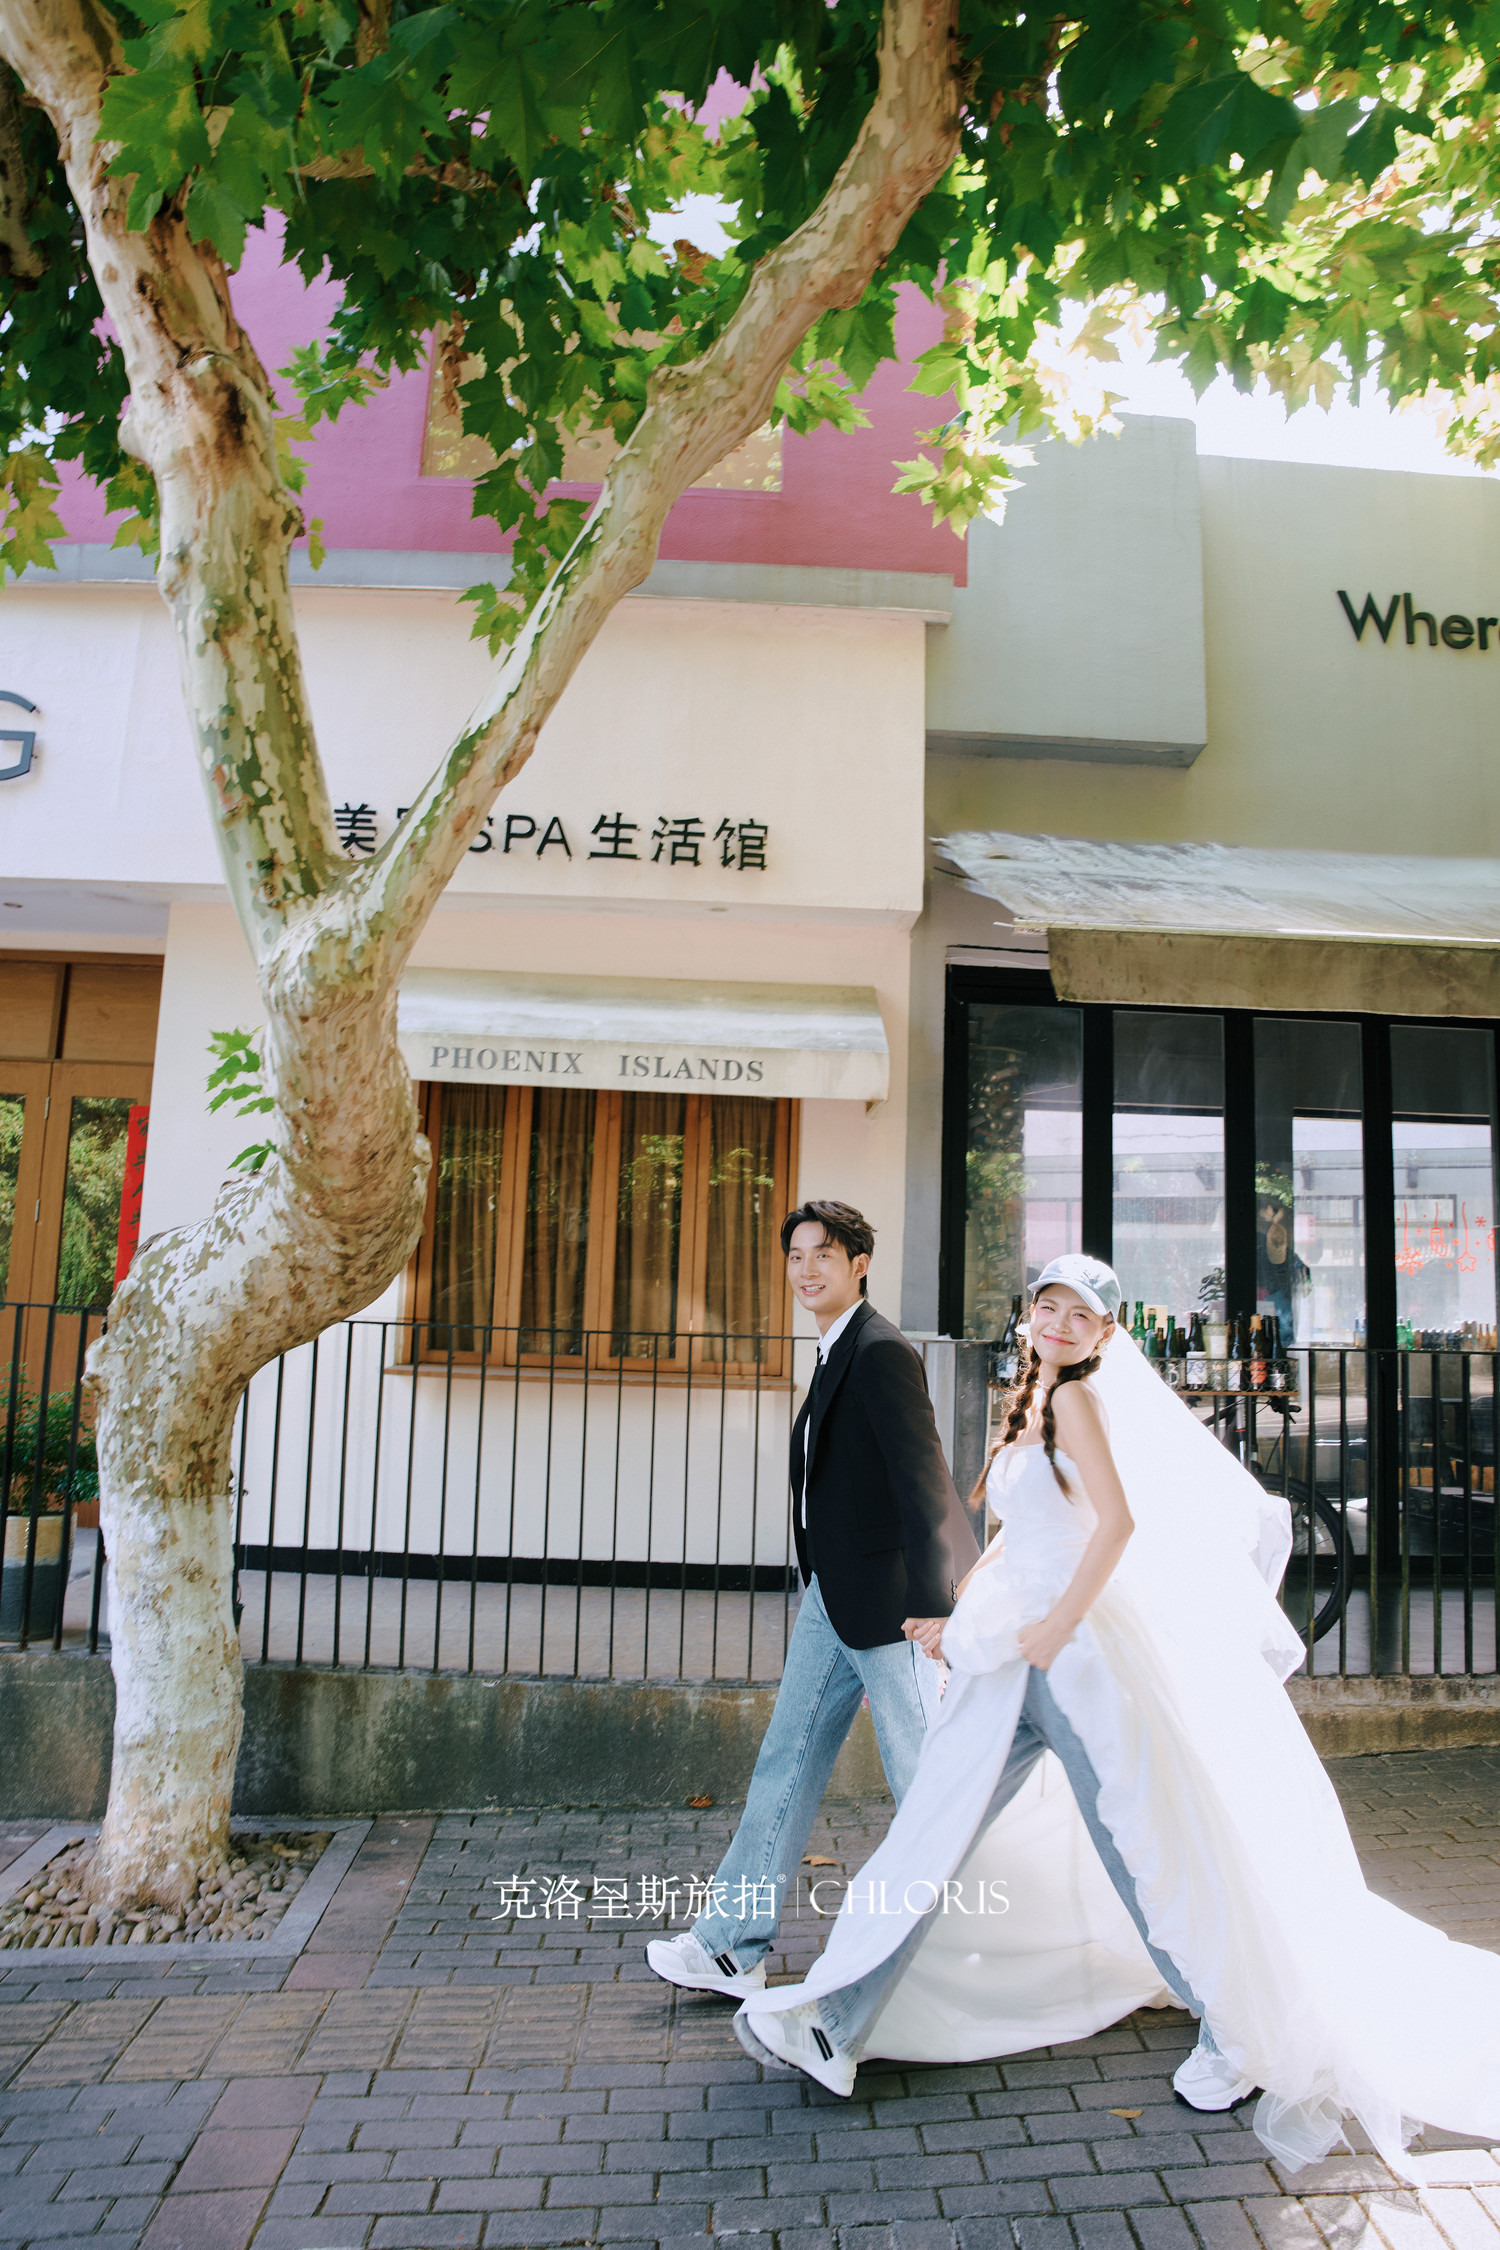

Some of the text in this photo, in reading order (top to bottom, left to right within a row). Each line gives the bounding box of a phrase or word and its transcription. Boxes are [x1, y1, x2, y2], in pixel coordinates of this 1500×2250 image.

[1336, 589, 1500, 651] Wher
[430, 1046, 765, 1083] PHOENIX ISLANDS
